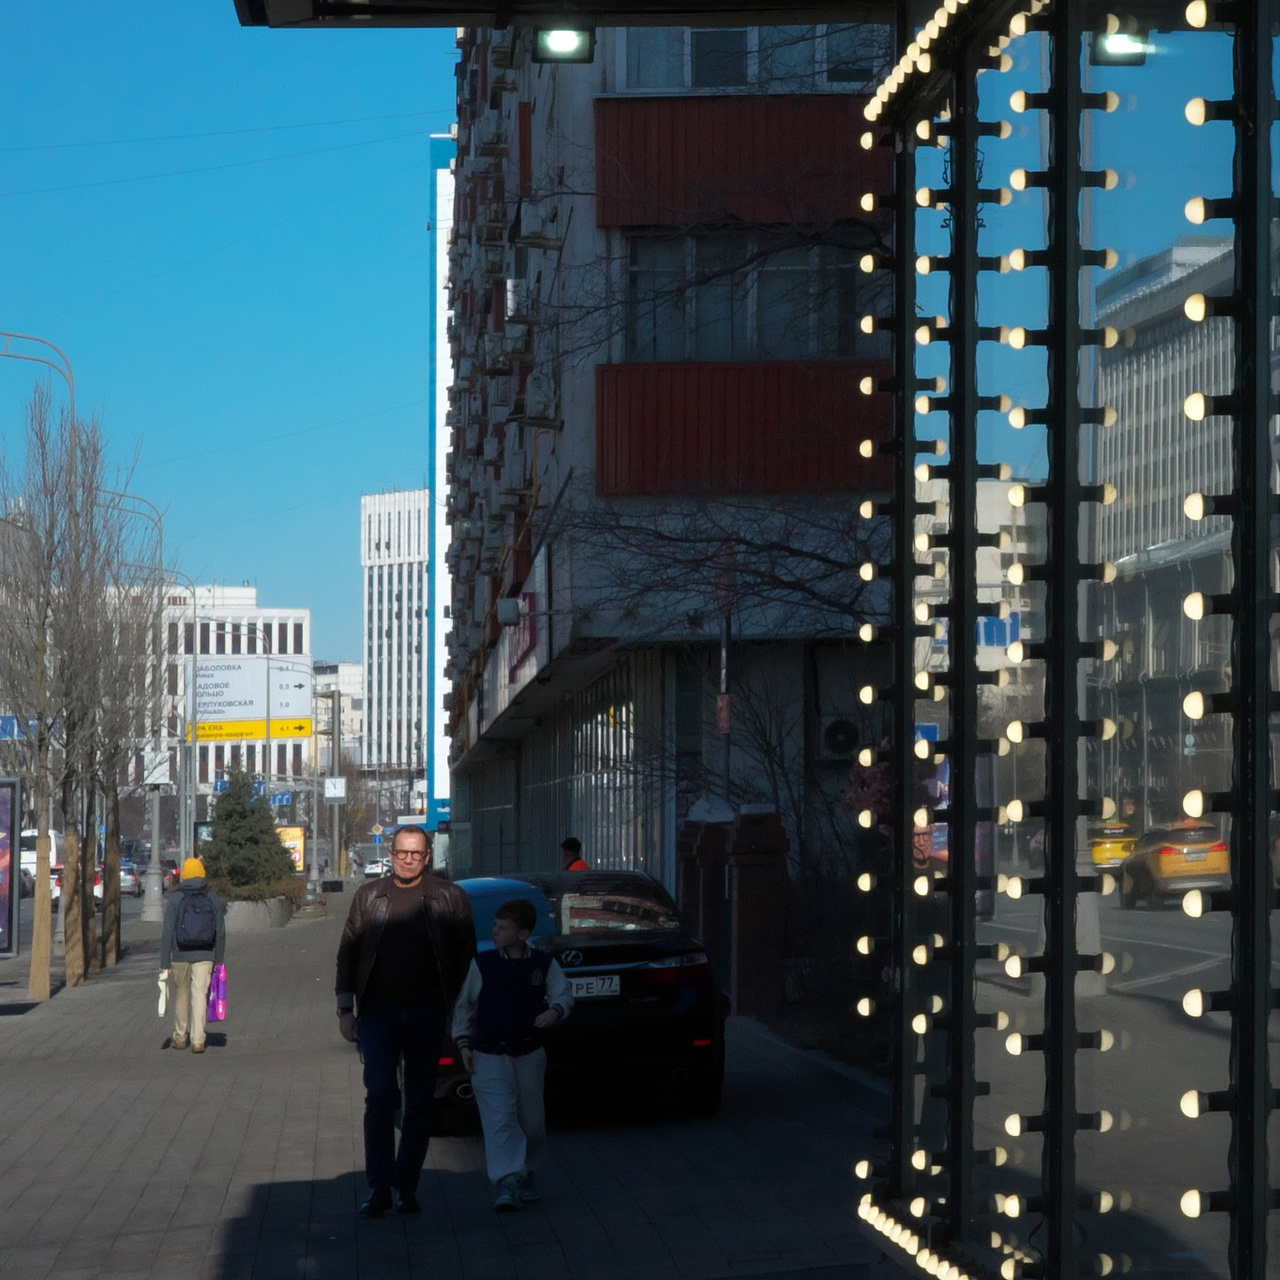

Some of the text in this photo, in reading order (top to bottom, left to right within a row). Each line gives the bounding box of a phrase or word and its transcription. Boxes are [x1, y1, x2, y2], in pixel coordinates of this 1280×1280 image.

[196, 664, 242, 672] АБОЛОВКА
[197, 682, 230, 690] АДОВОЕ
[197, 700, 254, 708] ЕРПУХОВСКАЯ
